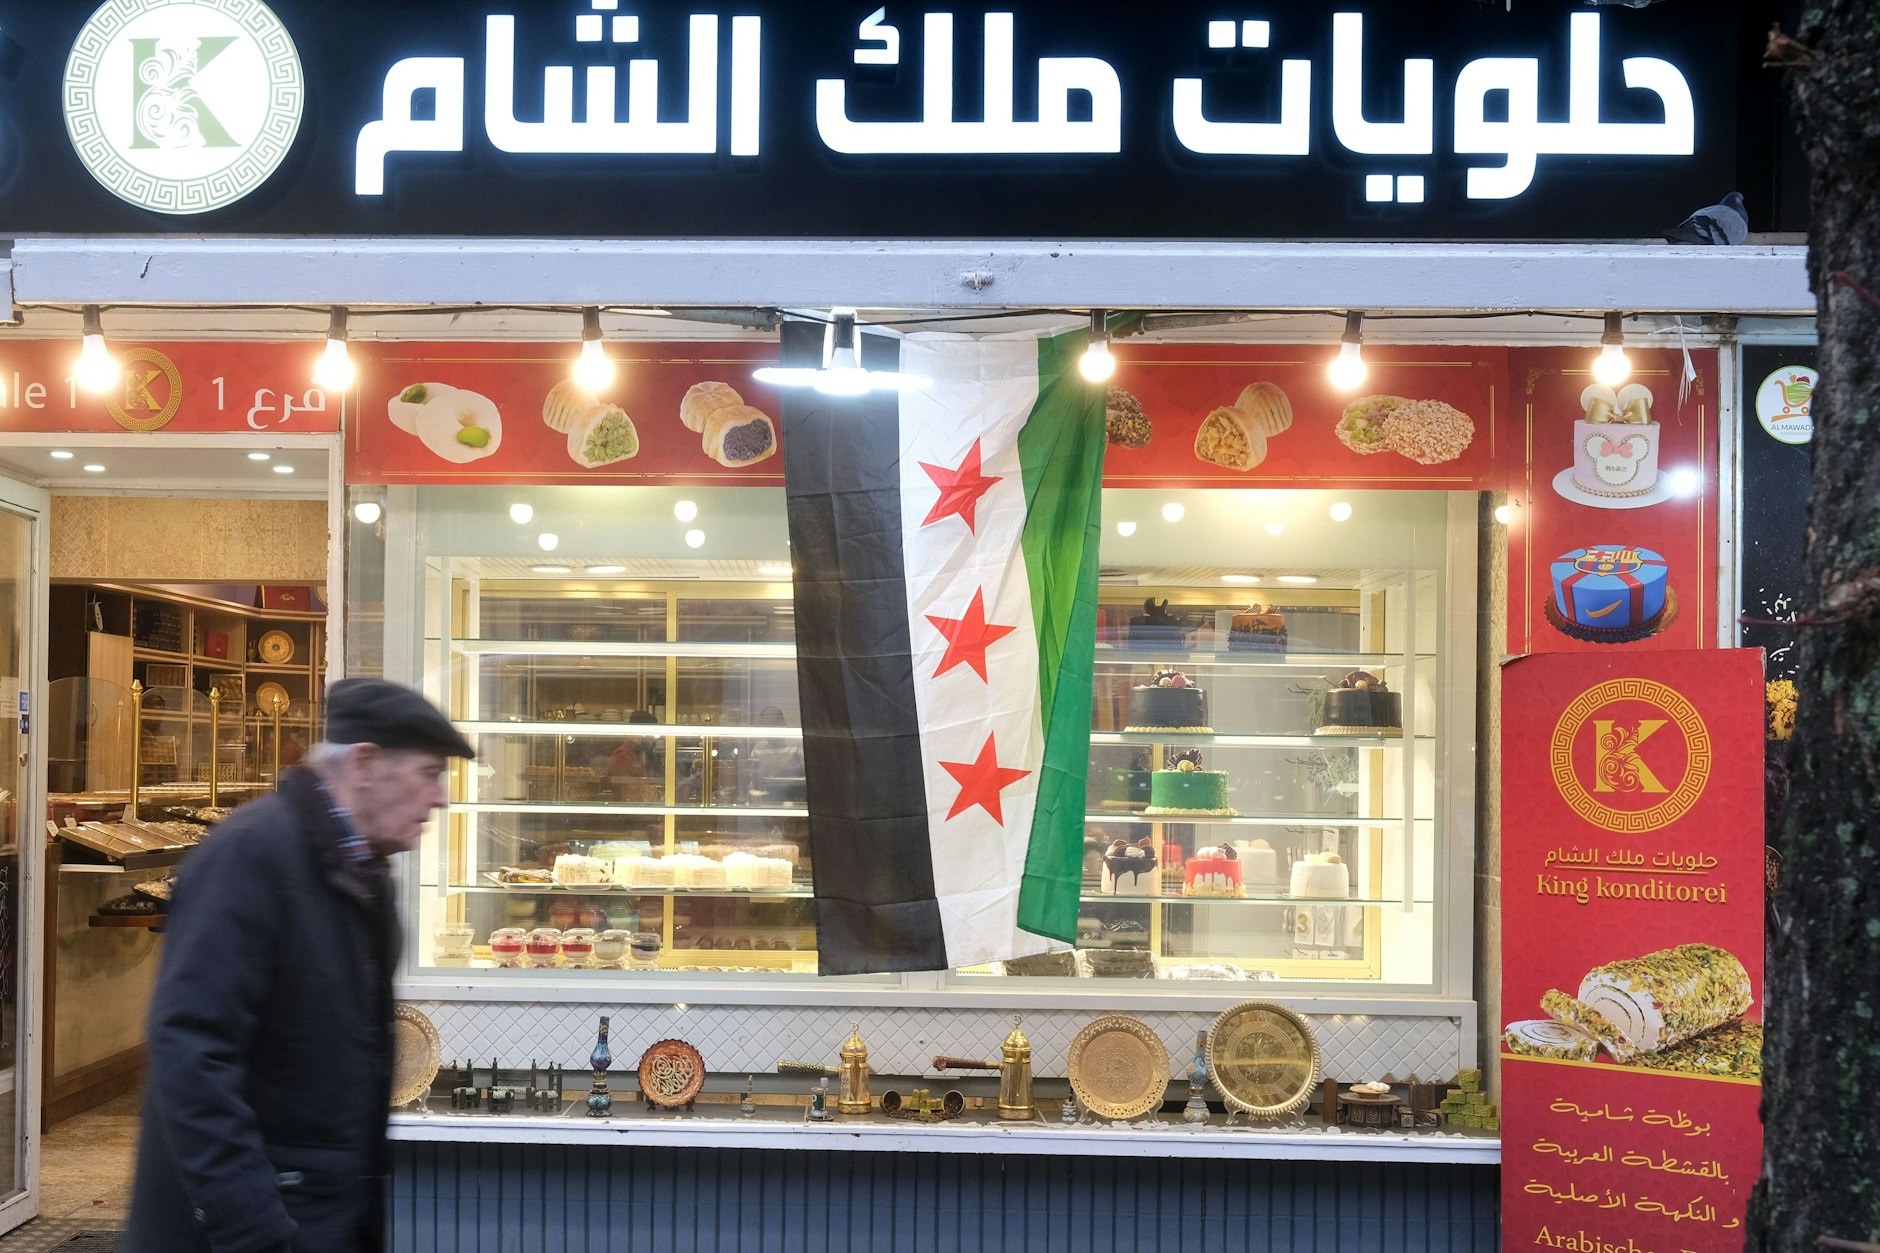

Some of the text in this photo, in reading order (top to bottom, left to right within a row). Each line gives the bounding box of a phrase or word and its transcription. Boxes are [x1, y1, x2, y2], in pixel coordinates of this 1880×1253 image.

[355, 0, 1694, 202] حلويات ملك الشام
[211, 375, 326, 429] فرع 1
[1544, 846, 1718, 871] حلويات ملك الشام
[1537, 874, 1727, 904] King konditorei
[1549, 1098, 1711, 1137] بوظة شامية
[1532, 1138, 1730, 1186] بالقشطة العربية
[1523, 1179, 1740, 1229] و النكهة الأصلية
[1534, 1225, 1656, 1253] Arabisch
